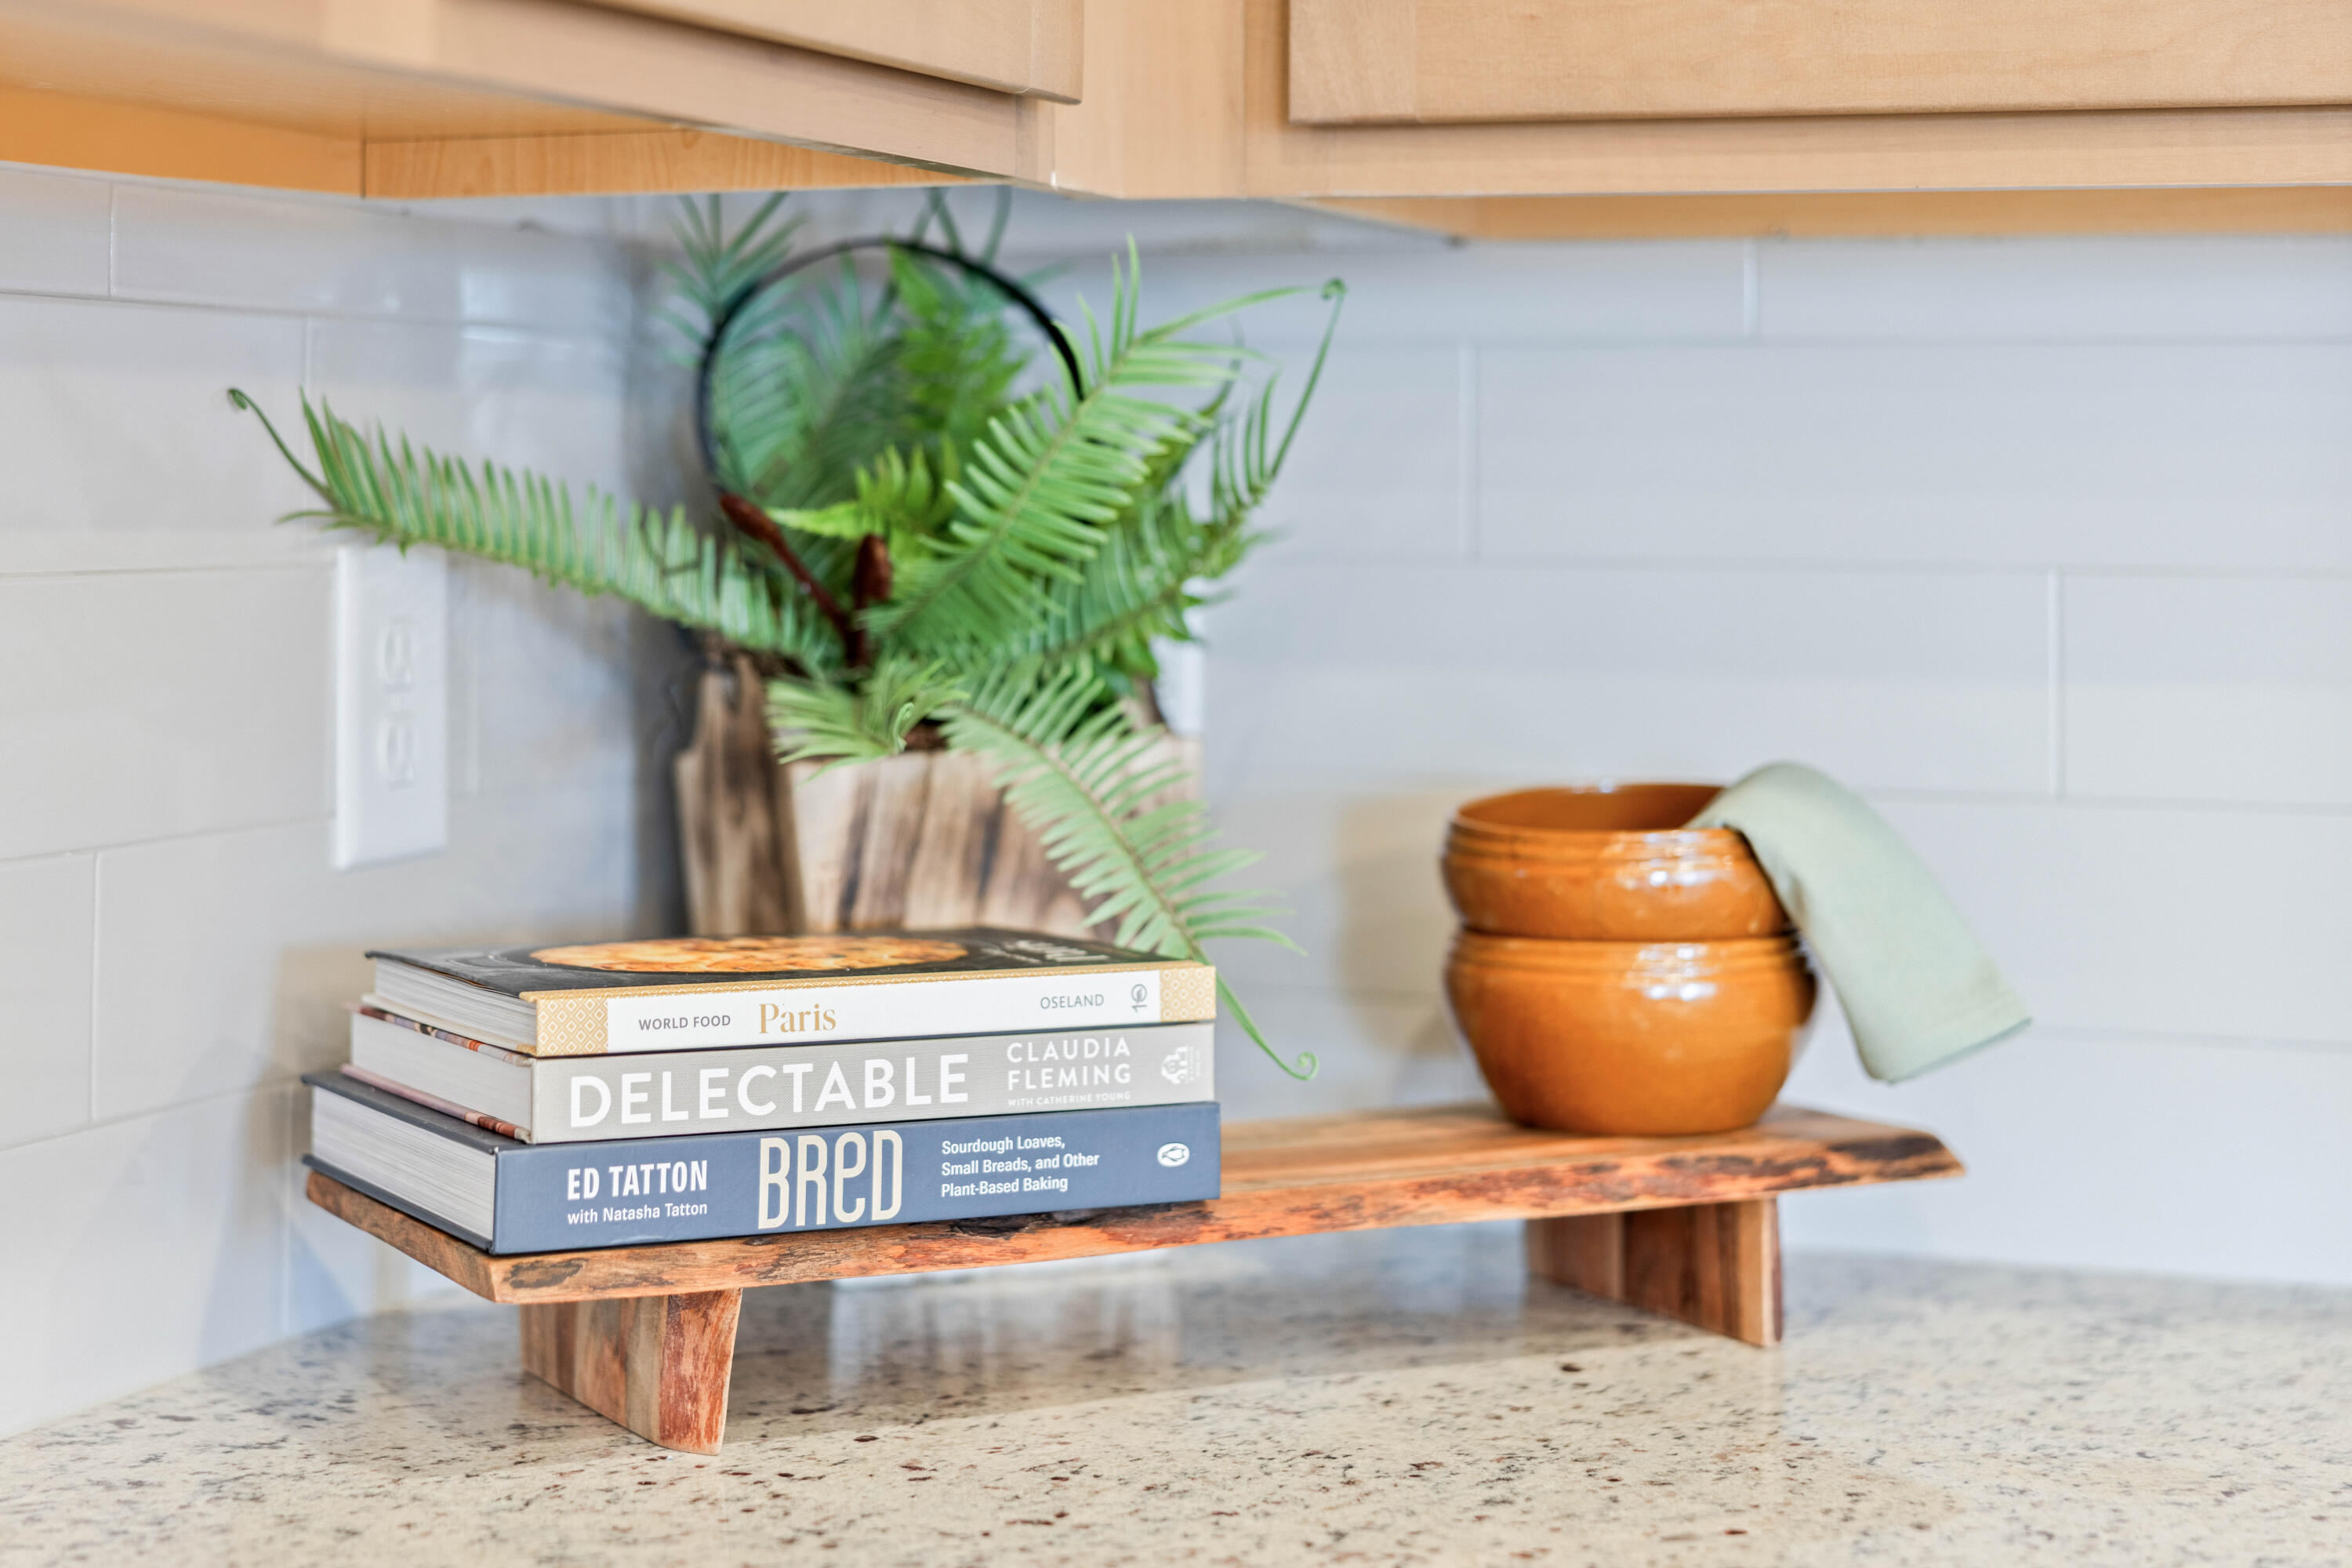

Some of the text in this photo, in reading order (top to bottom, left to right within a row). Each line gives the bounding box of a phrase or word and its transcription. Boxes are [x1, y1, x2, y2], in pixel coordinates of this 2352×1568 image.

[1040, 993, 1105, 1010] OSELAND
[638, 1014, 731, 1031] WORLD FOOD
[758, 1003, 837, 1034] Paris
[1006, 1036, 1131, 1063] CLAUDIA
[1007, 1063, 1132, 1091] FLEMING
[569, 1053, 969, 1128] DELECTABLE
[1008, 1091, 1131, 1107] WITH CATHERINE YOUNG
[942, 1136, 1066, 1155] Sourdough Loaves,
[942, 1152, 1100, 1176] Small Breads, and Other
[568, 1160, 708, 1201] ED TATTON
[941, 1176, 1069, 1198] Plant-Based Baking
[568, 1203, 707, 1225] with Natasha Tatton
